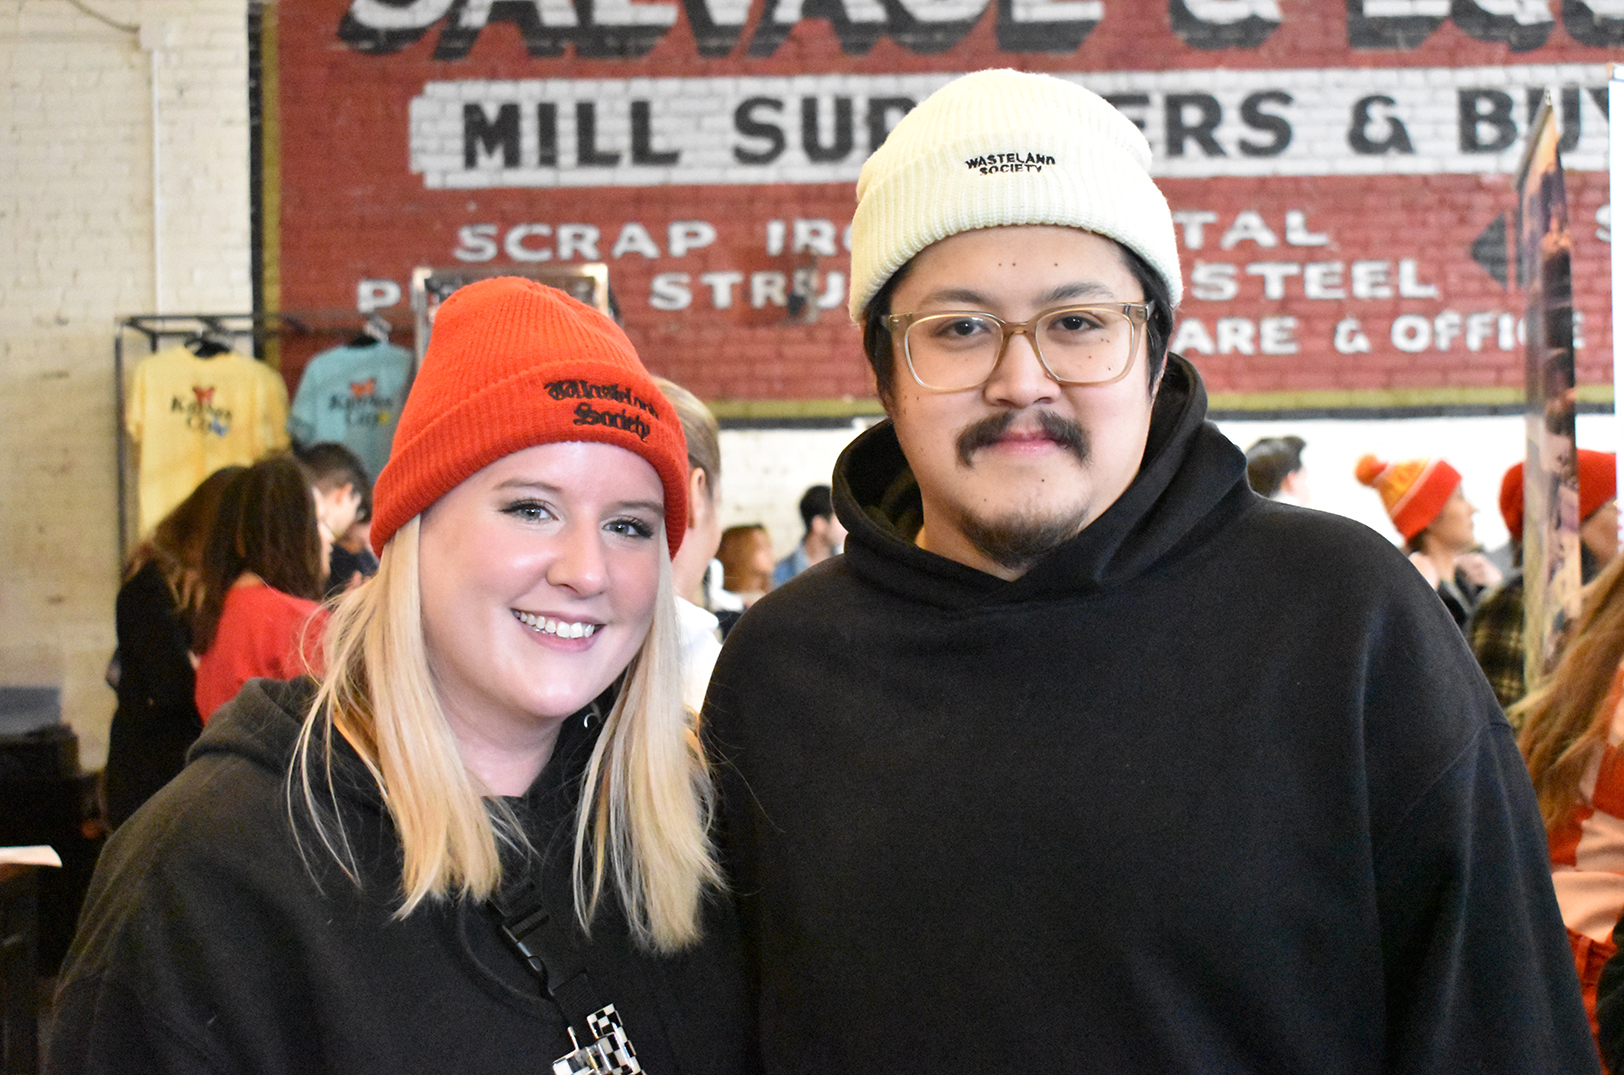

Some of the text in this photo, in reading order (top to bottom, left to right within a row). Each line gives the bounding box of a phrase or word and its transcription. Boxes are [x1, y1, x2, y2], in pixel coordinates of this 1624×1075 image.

[463, 99, 681, 168] MILL
[1348, 94, 1417, 156] &
[965, 152, 1056, 169] WASTELAND
[979, 163, 1042, 176] SOCIETY
[453, 210, 1330, 262] SCRAP IR TAL
[1191, 259, 1439, 301] STEEL
[1171, 312, 1585, 354] ARE & OFFI
